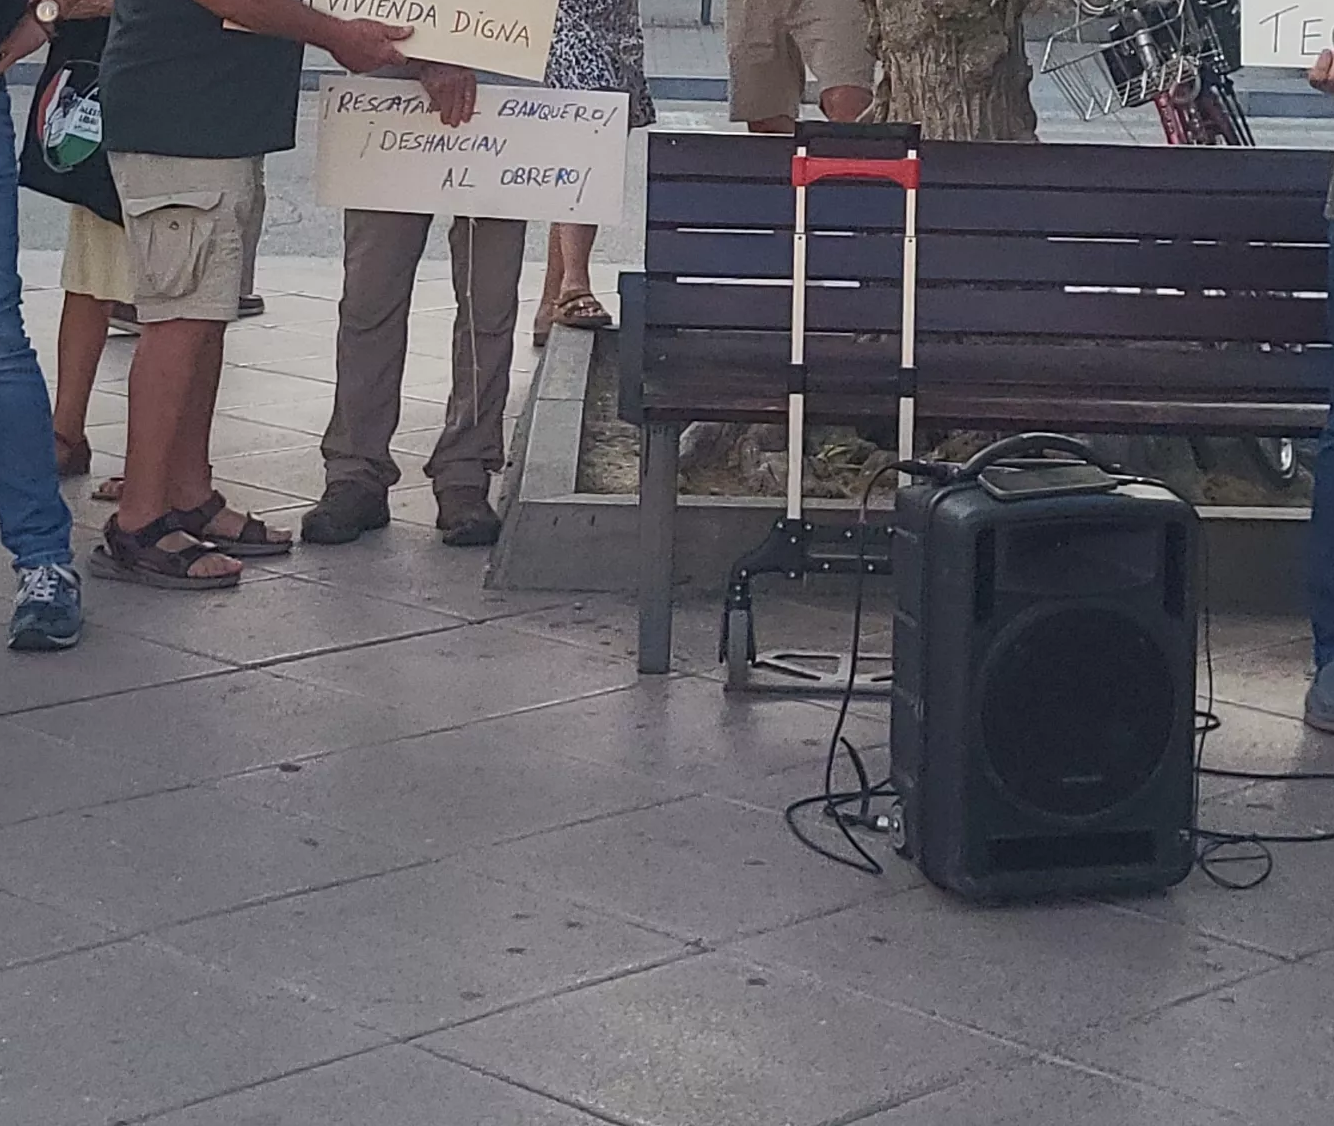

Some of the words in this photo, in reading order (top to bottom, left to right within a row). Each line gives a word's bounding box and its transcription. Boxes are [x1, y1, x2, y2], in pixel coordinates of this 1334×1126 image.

[498, 99, 618, 134] BANQUERO!
[441, 168, 476, 190] AL
[501, 167, 592, 211] OBRERO!
